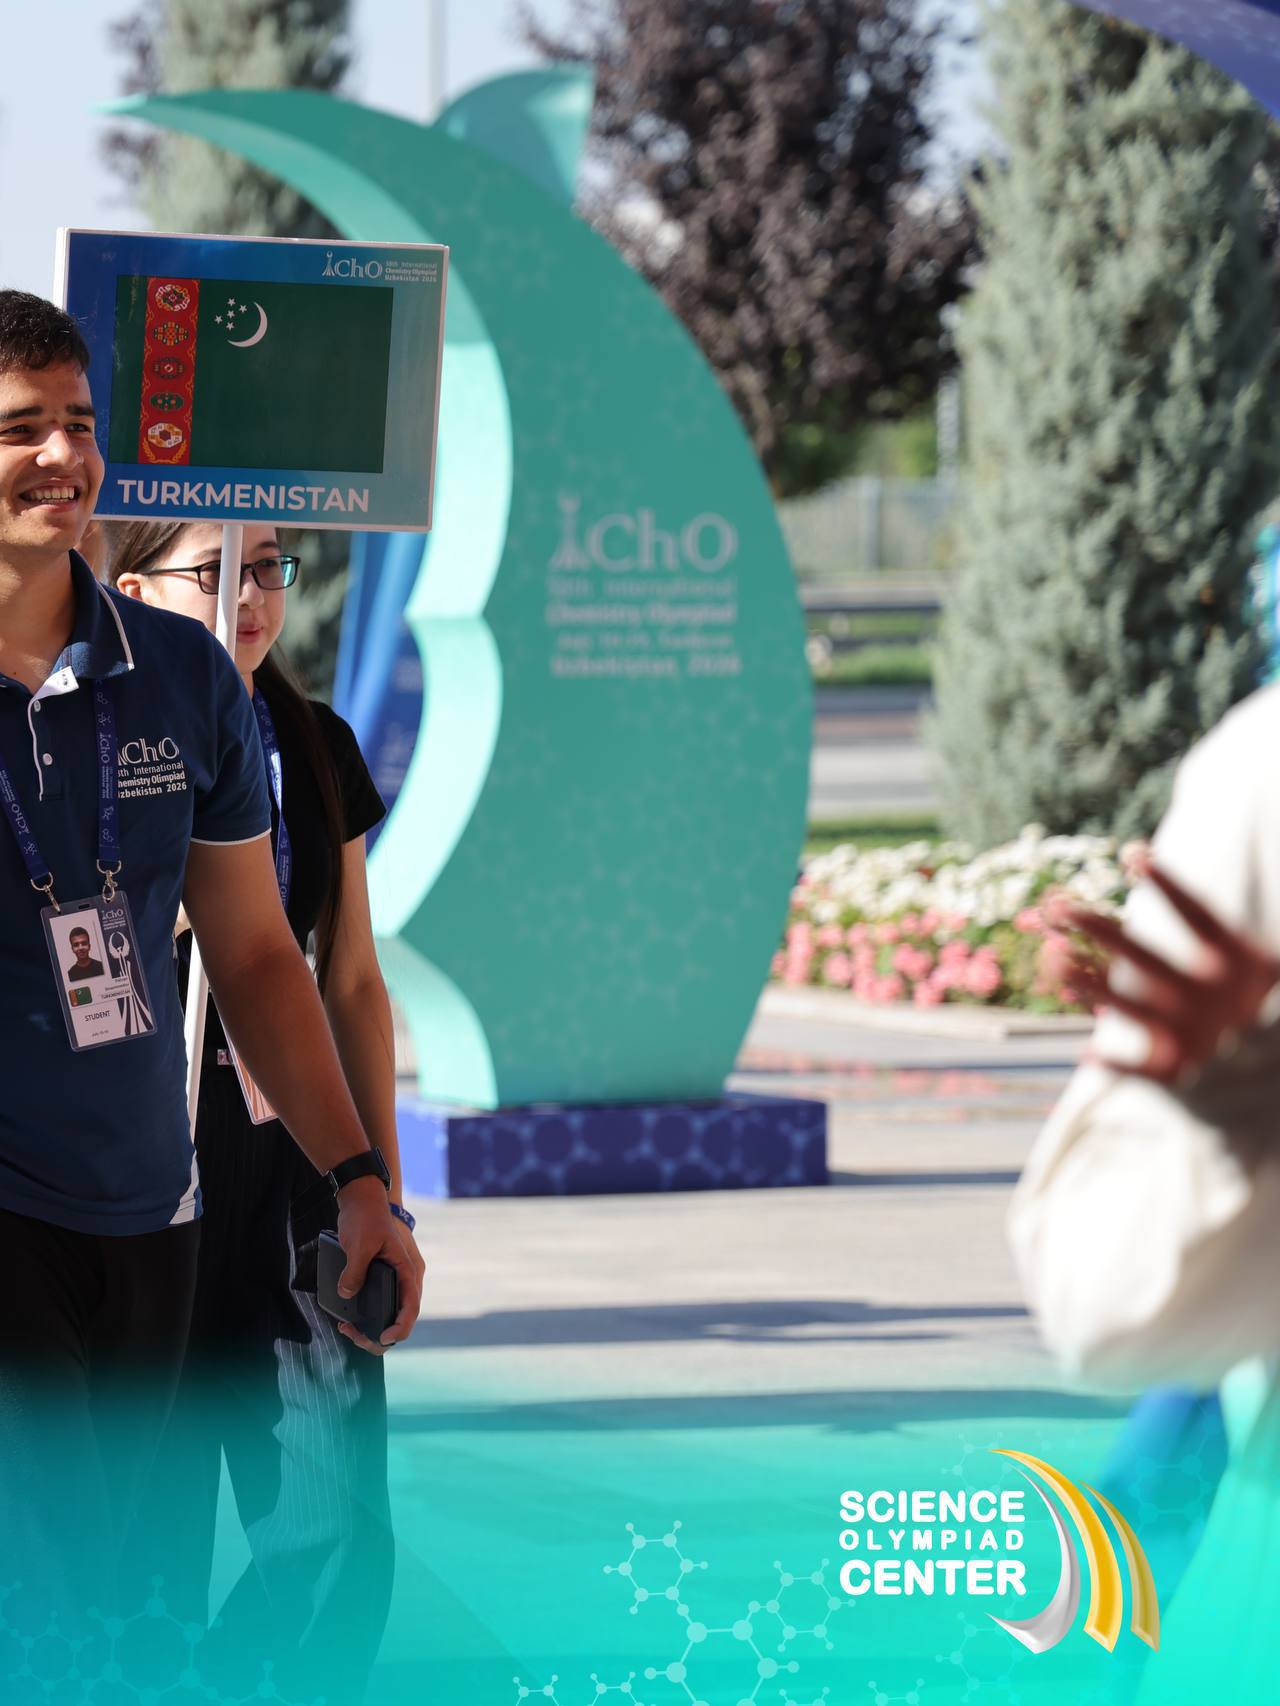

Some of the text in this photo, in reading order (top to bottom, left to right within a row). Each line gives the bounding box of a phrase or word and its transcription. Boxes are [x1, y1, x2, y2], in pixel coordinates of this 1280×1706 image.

[117, 478, 370, 513] TURKMENISTAN
[133, 760, 185, 776] International
[118, 776, 151, 789] hemistry
[118, 781, 187, 799] zbekistan 2026
[84, 1010, 111, 1022] STUDENT
